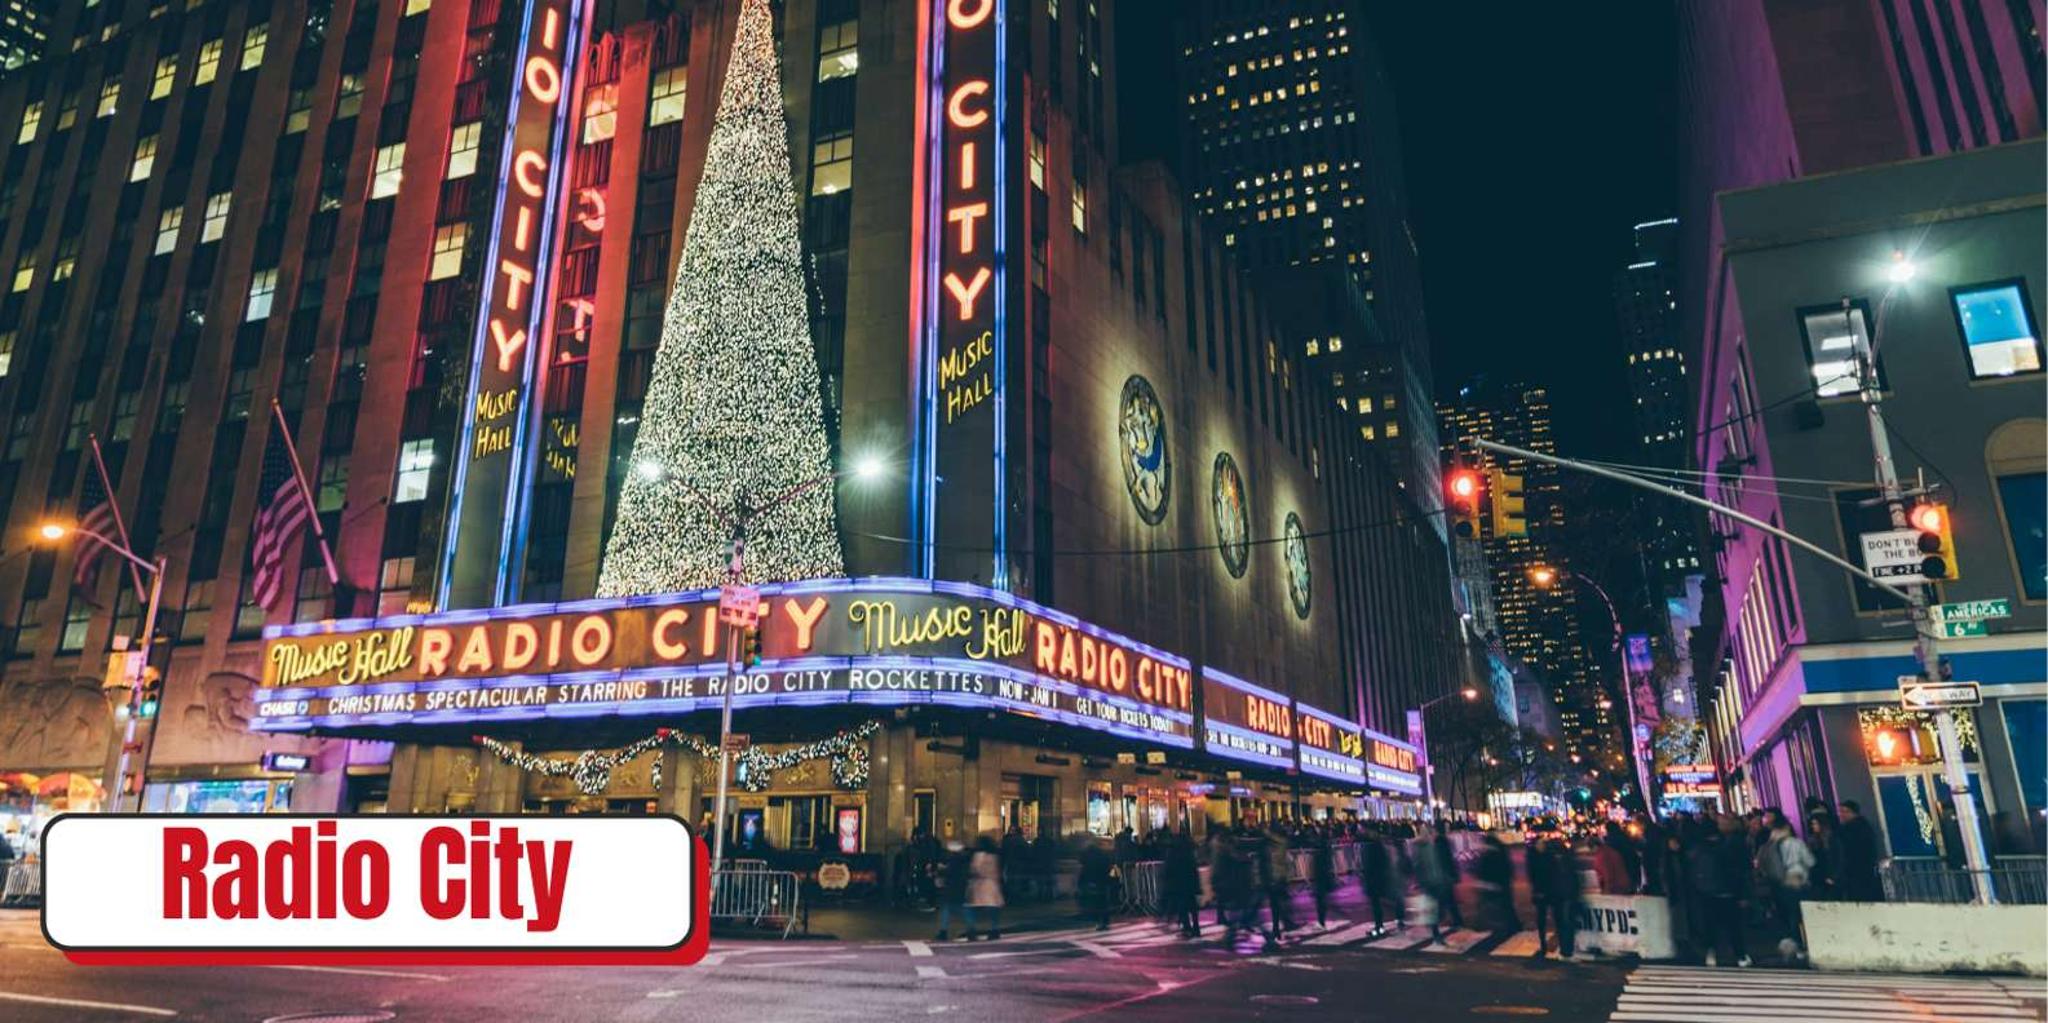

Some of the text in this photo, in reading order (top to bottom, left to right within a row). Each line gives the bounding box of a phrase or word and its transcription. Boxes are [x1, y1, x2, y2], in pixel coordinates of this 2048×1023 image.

[944, 80, 991, 320] CITY
[491, 150, 548, 372] CITY
[941, 330, 992, 390] MUSIC
[475, 389, 517, 423] MUSIC
[948, 372, 992, 424] HALL
[475, 426, 511, 458] HALL
[1884, 549, 1905, 559] THE
[1947, 604, 2006, 619] AMERICAS
[1954, 623, 1966, 636] 6
[272, 641, 348, 685] Music
[338, 626, 414, 685] Hall
[418, 616, 613, 676] RADIO
[652, 597, 828, 660] CIY
[849, 600, 1190, 708] Music Hall RADIO CITY
[328, 693, 416, 715] CHRISTMAS
[425, 686, 547, 710] SPECTACULAR
[558, 681, 647, 703] STARRING
[661, 678, 694, 697] THE
[784, 670, 832, 692] CITY
[850, 667, 984, 692] ROCKETTES
[999, 679, 1023, 699] NOW
[1031, 686, 1051, 707] JAN
[1076, 697, 1092, 714] GET
[1096, 702, 1118, 722] YOUR
[1247, 694, 1291, 737] RADIO
[1305, 715, 1330, 749] CITY
